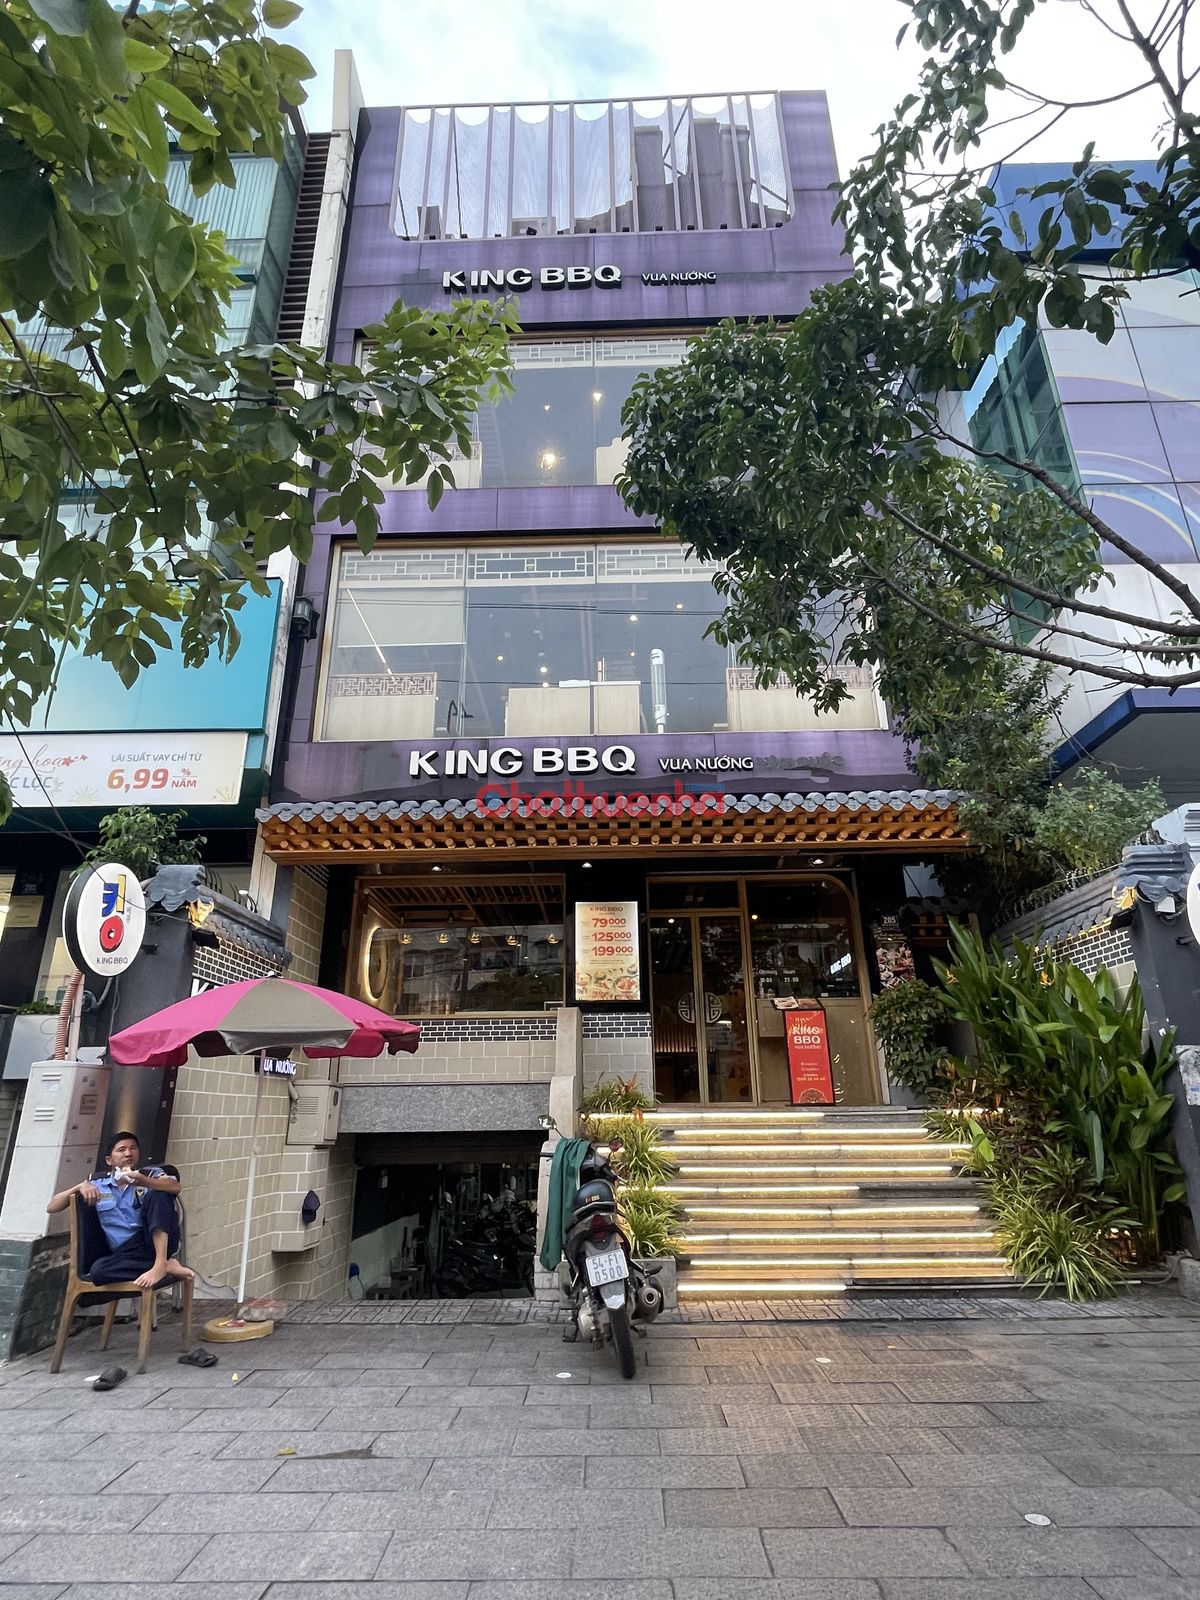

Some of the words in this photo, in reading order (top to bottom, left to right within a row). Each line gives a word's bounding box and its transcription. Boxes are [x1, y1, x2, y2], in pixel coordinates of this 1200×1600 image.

[442, 268, 532, 289] KING
[540, 265, 621, 286] BBQ
[642, 273, 668, 282] VUA
[670, 271, 717, 281] NƯỚNG
[153, 754, 171, 762] VAY
[408, 747, 523, 776] KING
[532, 745, 636, 775] BBQ
[659, 758, 692, 771] VUA
[694, 754, 754, 770] NƯỚNG
[181, 767, 192, 777] %
[107, 767, 170, 794] 6,99
[171, 777, 197, 789] NĂM
[96, 956, 113, 965] KING
[114, 956, 129, 965] BBQ
[792, 1025, 820, 1035] KING
[793, 1035, 821, 1045] BBQ
[594, 1265, 623, 1283] 0500
